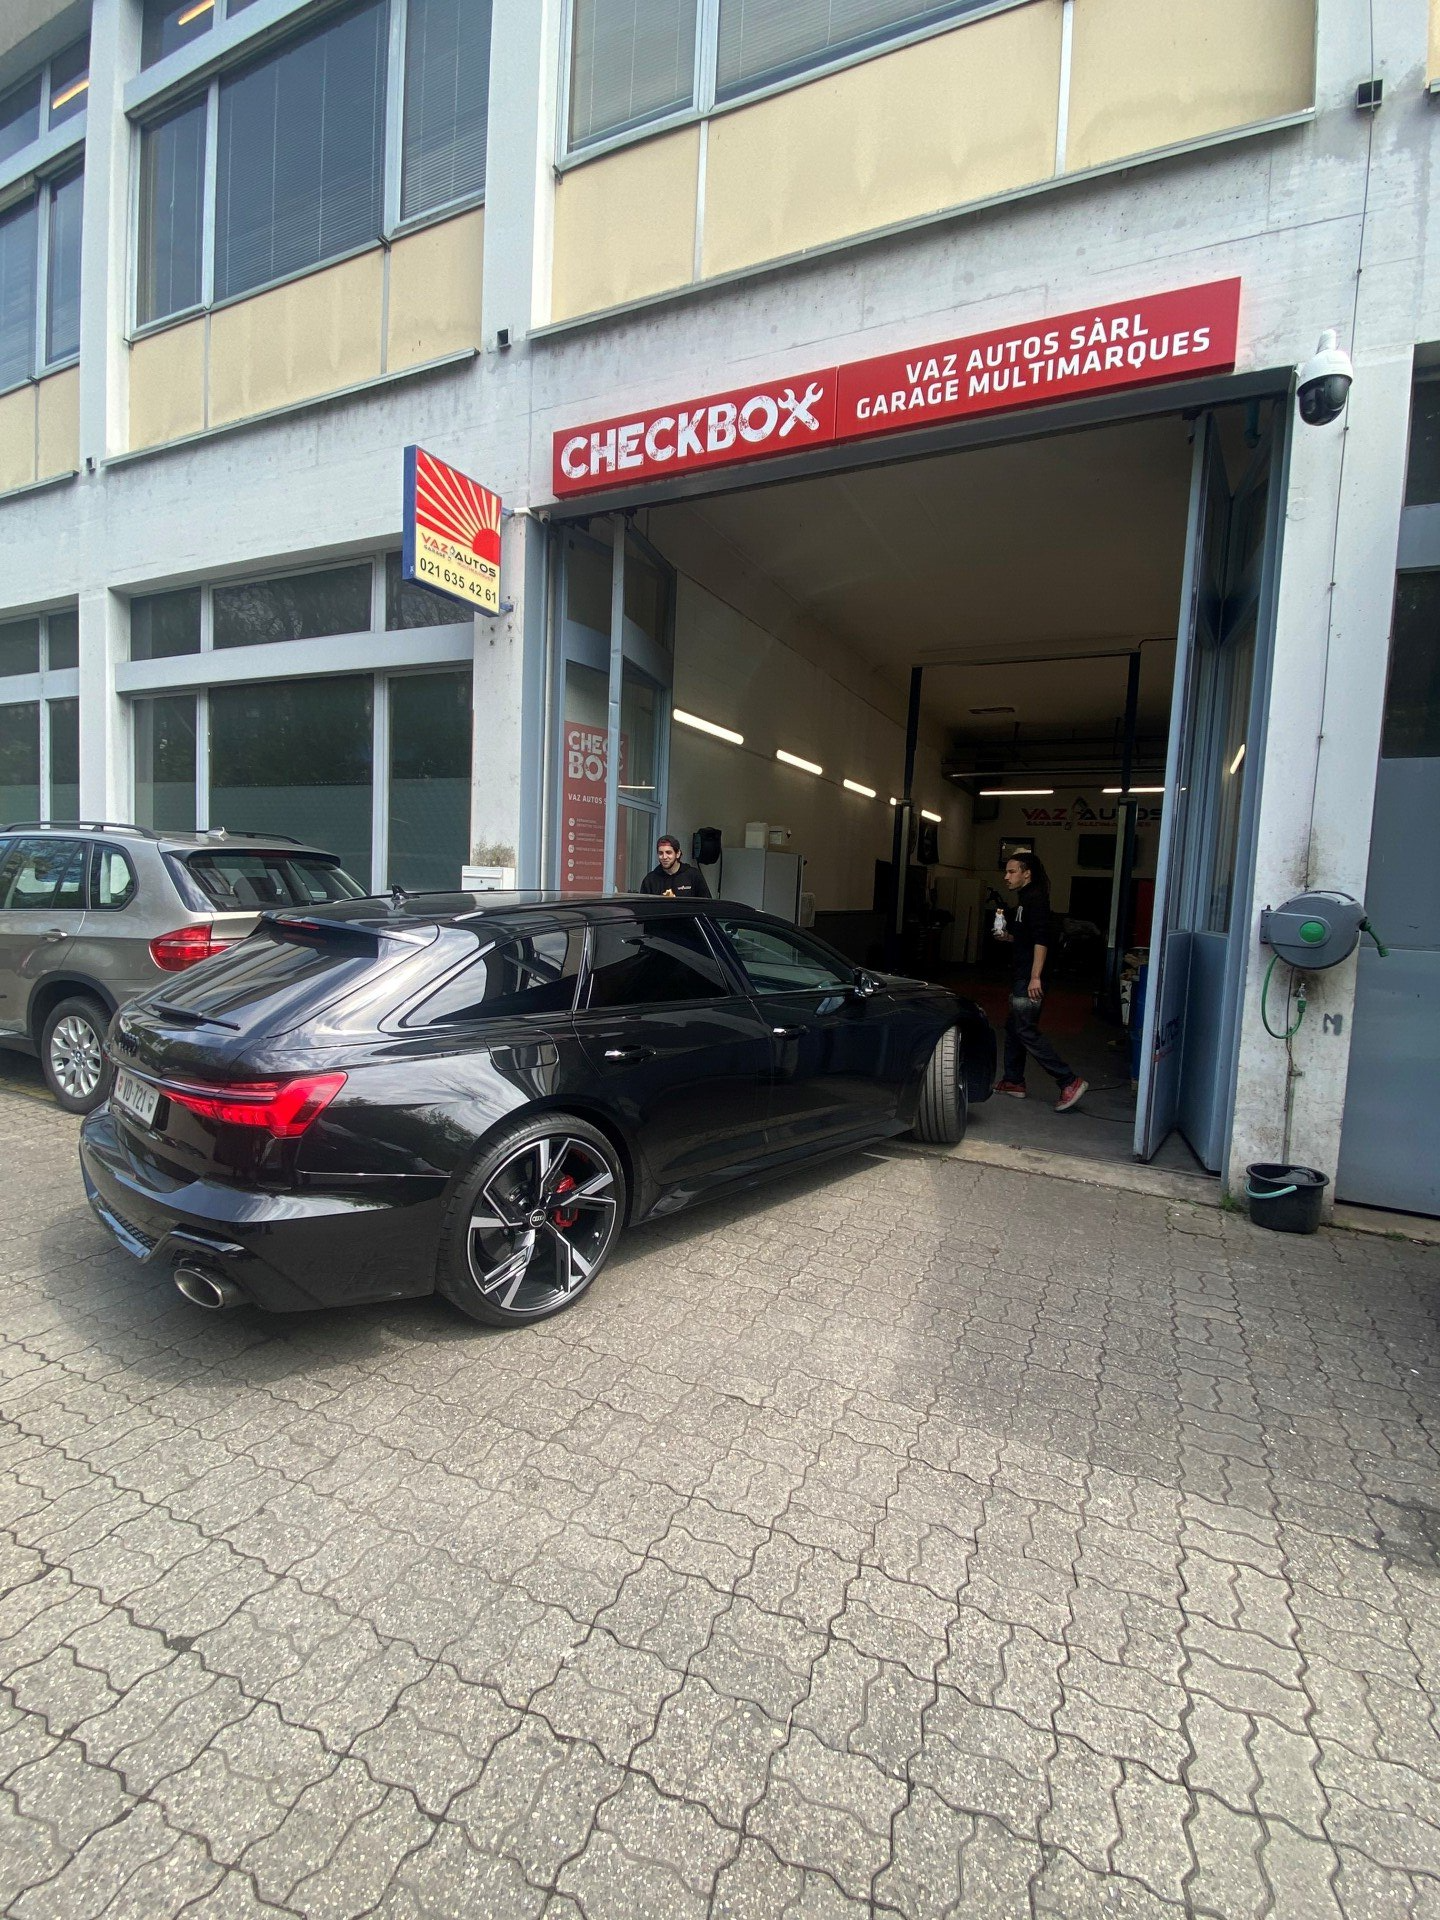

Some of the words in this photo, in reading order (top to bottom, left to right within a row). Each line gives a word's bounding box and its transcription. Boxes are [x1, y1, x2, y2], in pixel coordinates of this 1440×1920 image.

[906, 353, 958, 384] VAZ
[965, 331, 1059, 372] AUTOS
[1069, 313, 1149, 350] SÀRL
[856, 378, 959, 419] GARAGE
[968, 327, 1210, 397] MULTIMARQUES
[560, 382, 824, 479] CHECKBOX
[421, 532, 449, 554] VAZ
[455, 551, 496, 578] AUTOS
[420, 557, 440, 578] 021
[444, 569, 465, 589] 635
[469, 581, 482, 597] 42
[485, 588, 497, 604] 61
[567, 793, 581, 802] VAZ
[582, 795, 603, 805] AUTOS
[1021, 807, 1067, 821] VAZ
[1079, 807, 1162, 821] AUOS
